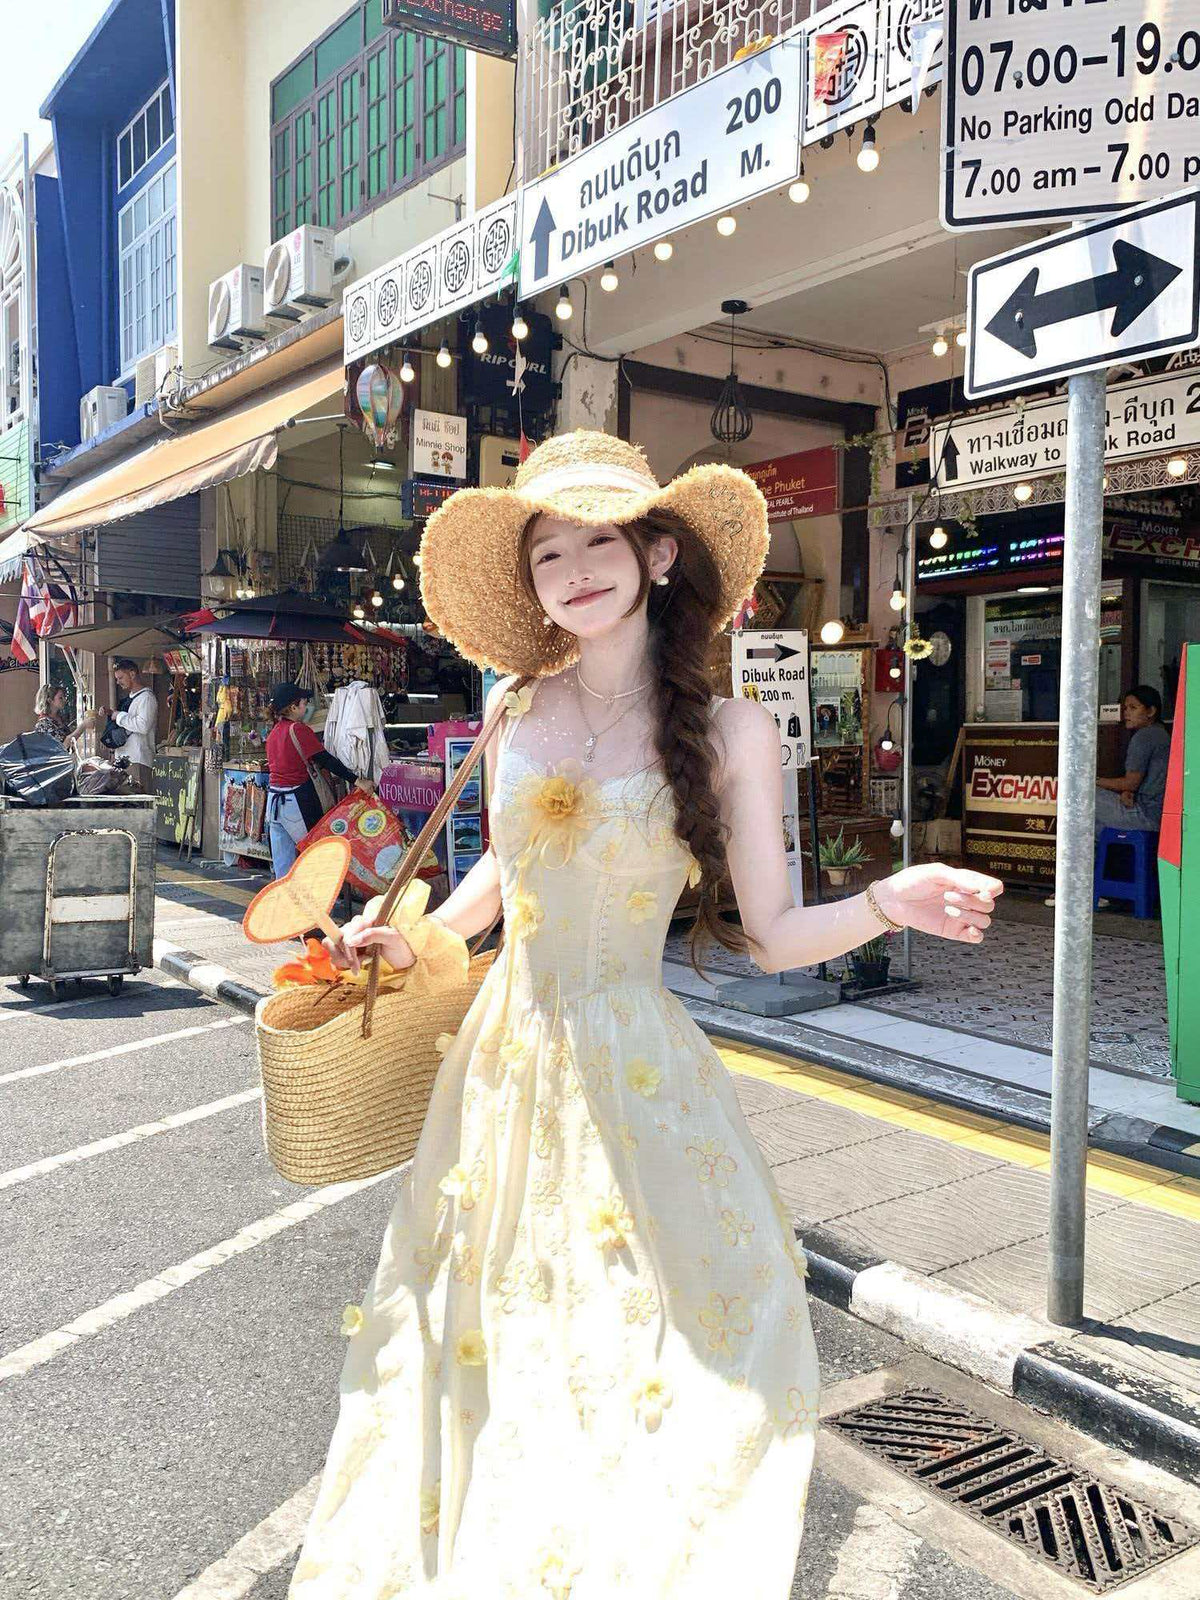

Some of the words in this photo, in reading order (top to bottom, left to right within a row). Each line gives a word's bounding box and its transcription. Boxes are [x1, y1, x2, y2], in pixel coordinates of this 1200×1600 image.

[726, 78, 782, 135] 200
[961, 115, 991, 142] No
[1004, 104, 1093, 137] Parking
[1105, 95, 1154, 125] Odd
[580, 129, 681, 208] ถนนดีบุก
[741, 143, 770, 178] M.
[961, 159, 1021, 198] 7.00
[561, 200, 628, 261] Dibuk
[637, 160, 708, 224] Road
[480, 353, 507, 366] RIP
[508, 359, 547, 375] CRL
[416, 437, 442, 450] Minnie
[445, 442, 466, 455] Shop
[1127, 423, 1175, 447] Road
[970, 452, 1038, 476] Walkway
[1044, 447, 1061, 461] to
[774, 477, 806, 494] Phuket
[1141, 521, 1180, 536] MONEY
[742, 668, 776, 683] Dibuk
[778, 667, 805, 681] Road
[760, 690, 779, 701] 200
[782, 690, 795, 700] m.
[378, 783, 441, 807] NFORMATION
[971, 770, 1058, 801] EXCHAN
